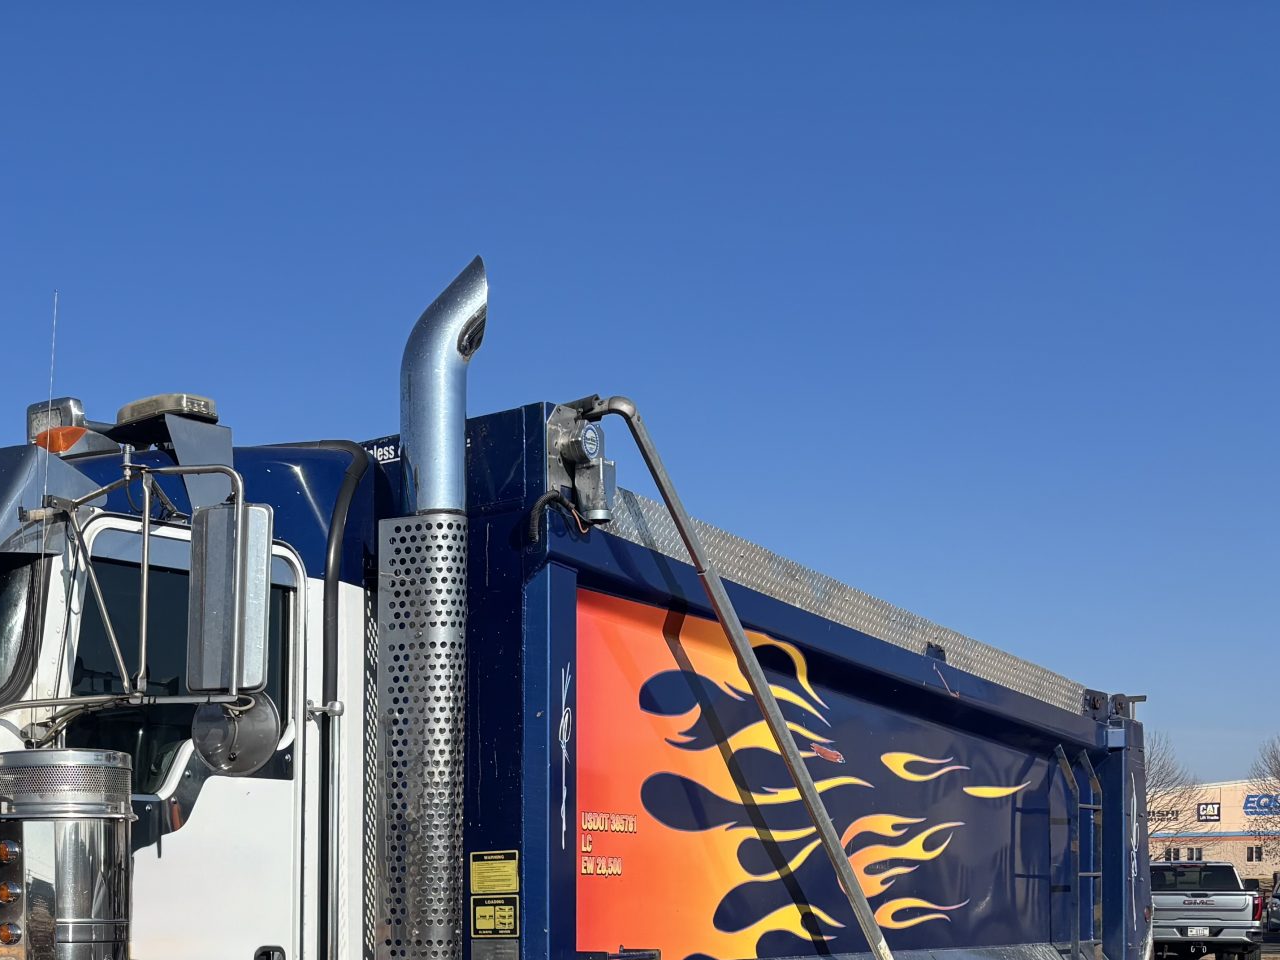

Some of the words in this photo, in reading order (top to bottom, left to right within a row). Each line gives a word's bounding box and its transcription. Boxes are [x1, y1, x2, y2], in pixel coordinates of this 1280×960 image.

[1200, 804, 1219, 815] CAT
[581, 812, 609, 831] USDOT
[581, 834, 592, 853] LC
[581, 856, 595, 875] EW
